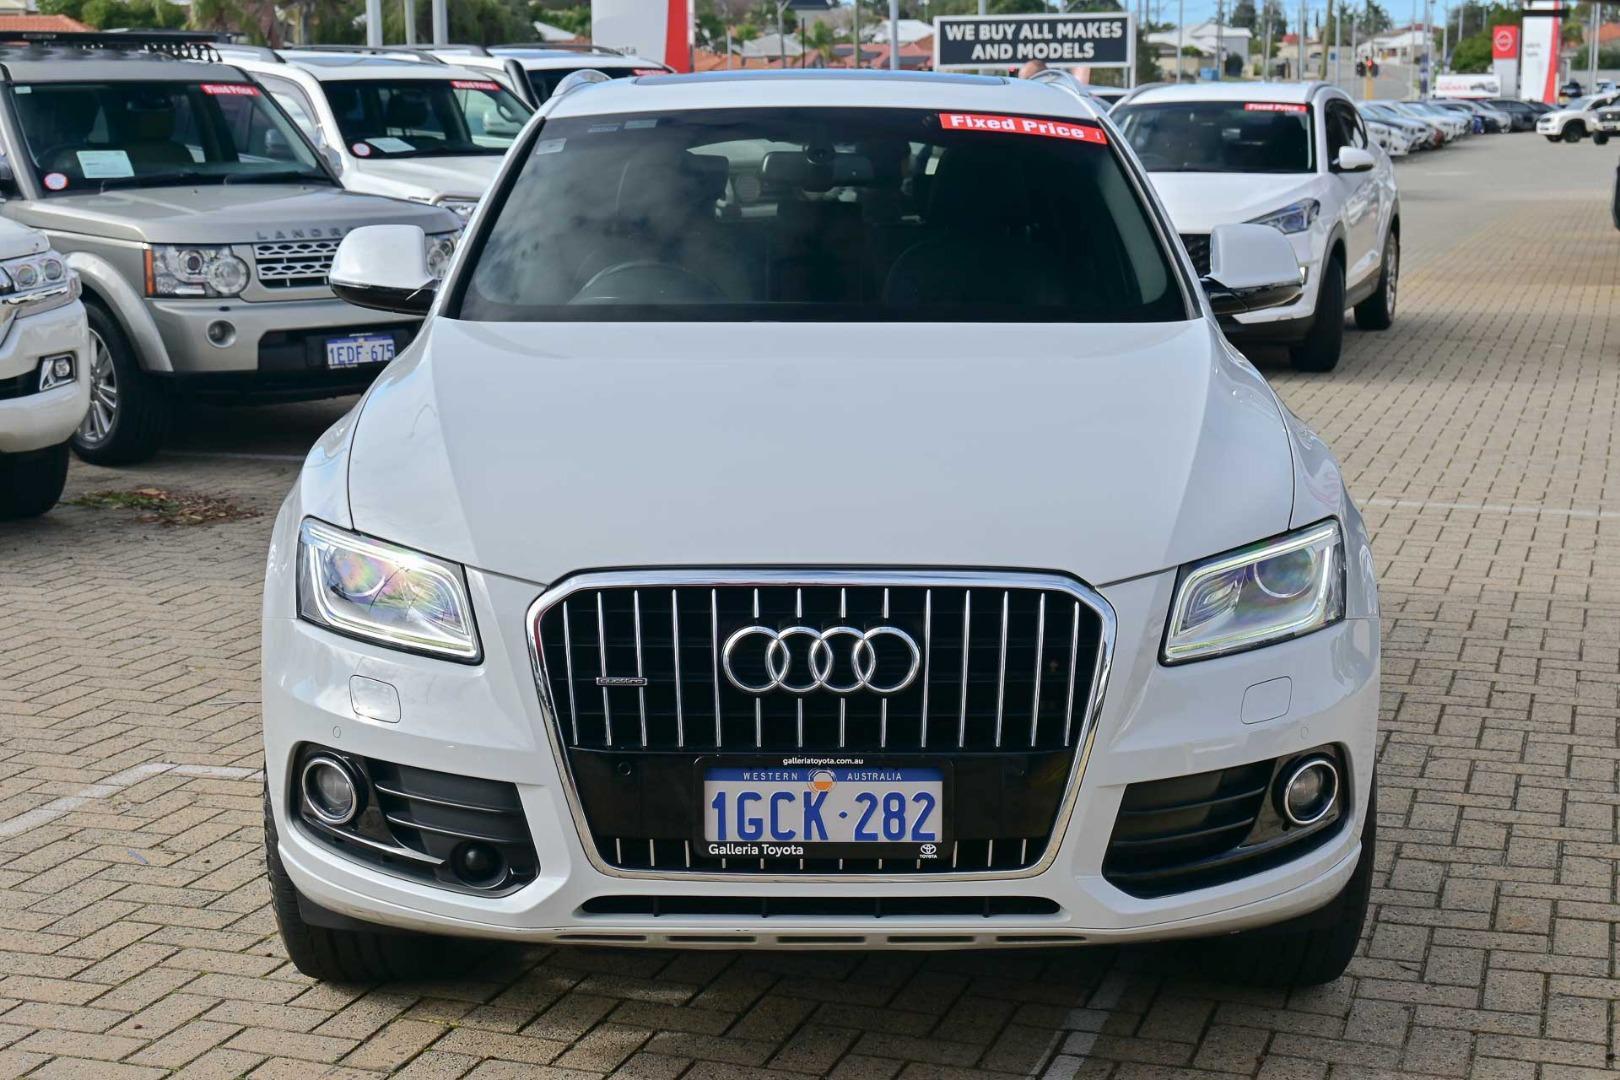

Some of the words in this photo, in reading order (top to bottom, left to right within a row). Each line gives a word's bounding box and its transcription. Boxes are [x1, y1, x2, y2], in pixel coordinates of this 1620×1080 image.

[945, 23, 975, 41] WE
[979, 23, 1016, 40] BUY
[1019, 22, 1053, 40] ALL
[1057, 21, 1122, 39] MAKES
[971, 43, 1013, 60] AND
[1017, 42, 1095, 59] MODELS
[950, 115, 1015, 130] Fixed
[1023, 119, 1085, 138] Price
[783, 757, 864, 766] galleriatoyota.com.au
[743, 772, 798, 781] WESTERN
[847, 772, 902, 781] AUSTRALIA
[708, 843, 759, 856] Galleria
[761, 844, 804, 858] Toyota
